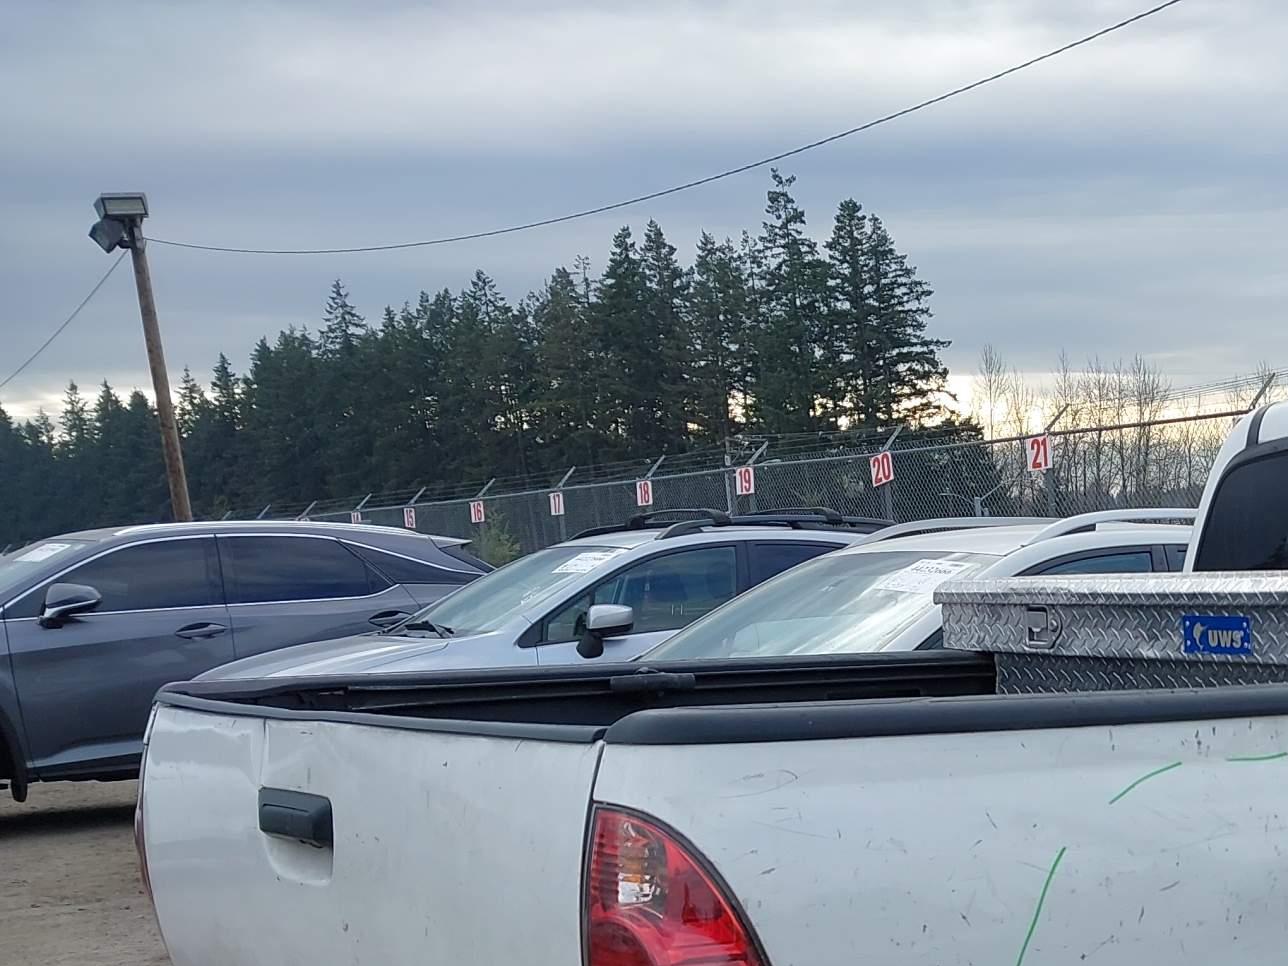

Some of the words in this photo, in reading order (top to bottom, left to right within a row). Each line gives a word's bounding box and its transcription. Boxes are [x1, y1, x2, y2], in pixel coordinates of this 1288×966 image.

[1030, 437, 1049, 470] 21
[738, 468, 752, 493] 19
[872, 453, 892, 486] 20
[552, 493, 561, 515] 17
[638, 481, 650, 505] 18
[404, 507, 416, 529] 15
[472, 501, 483, 523] 16
[1207, 629, 1244, 649] UWS
